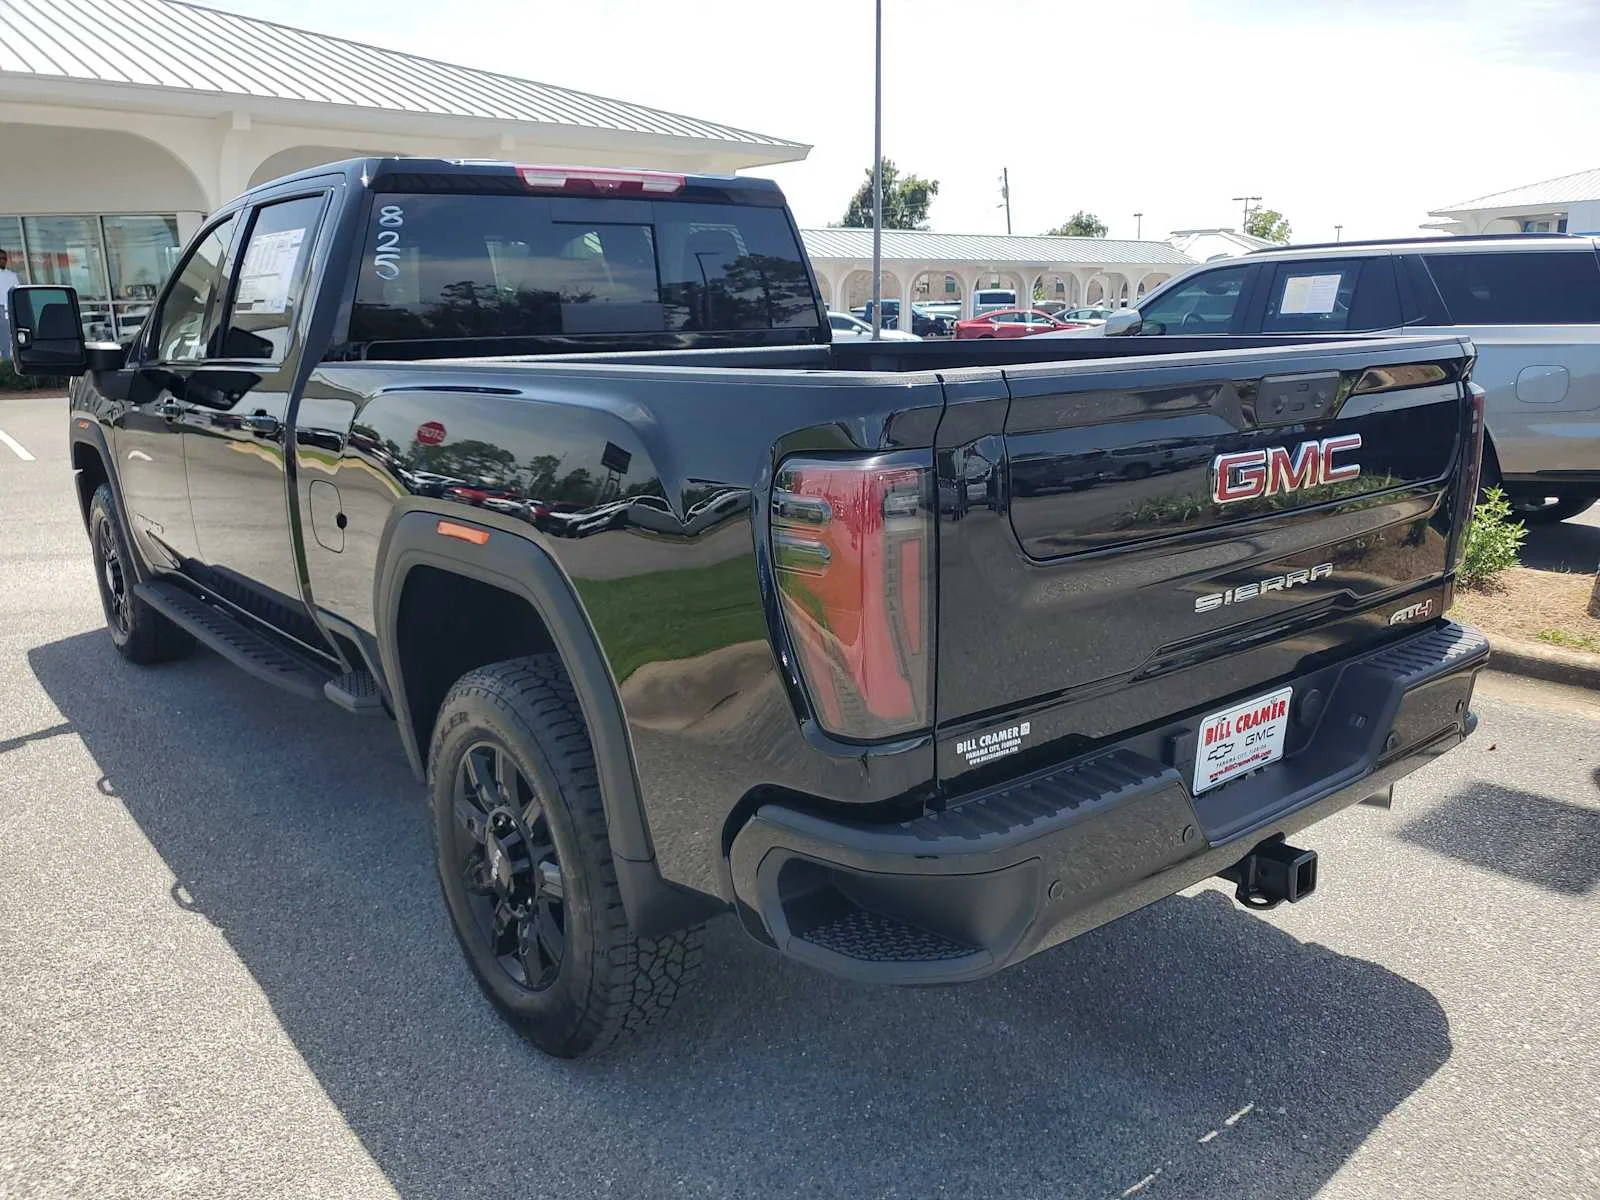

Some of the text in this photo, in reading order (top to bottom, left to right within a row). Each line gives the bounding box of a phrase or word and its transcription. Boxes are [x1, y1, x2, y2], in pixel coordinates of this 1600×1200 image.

[374, 205, 404, 281] 825
[1211, 433, 1362, 504] GMC
[1194, 562, 1334, 613] SIERRA
[1389, 599, 1433, 626] AT4
[957, 739, 977, 754] BILL
[979, 727, 1018, 746] CRAMER
[1205, 701, 1286, 745] BILL CRAMER
[1245, 725, 1276, 746] GMC
